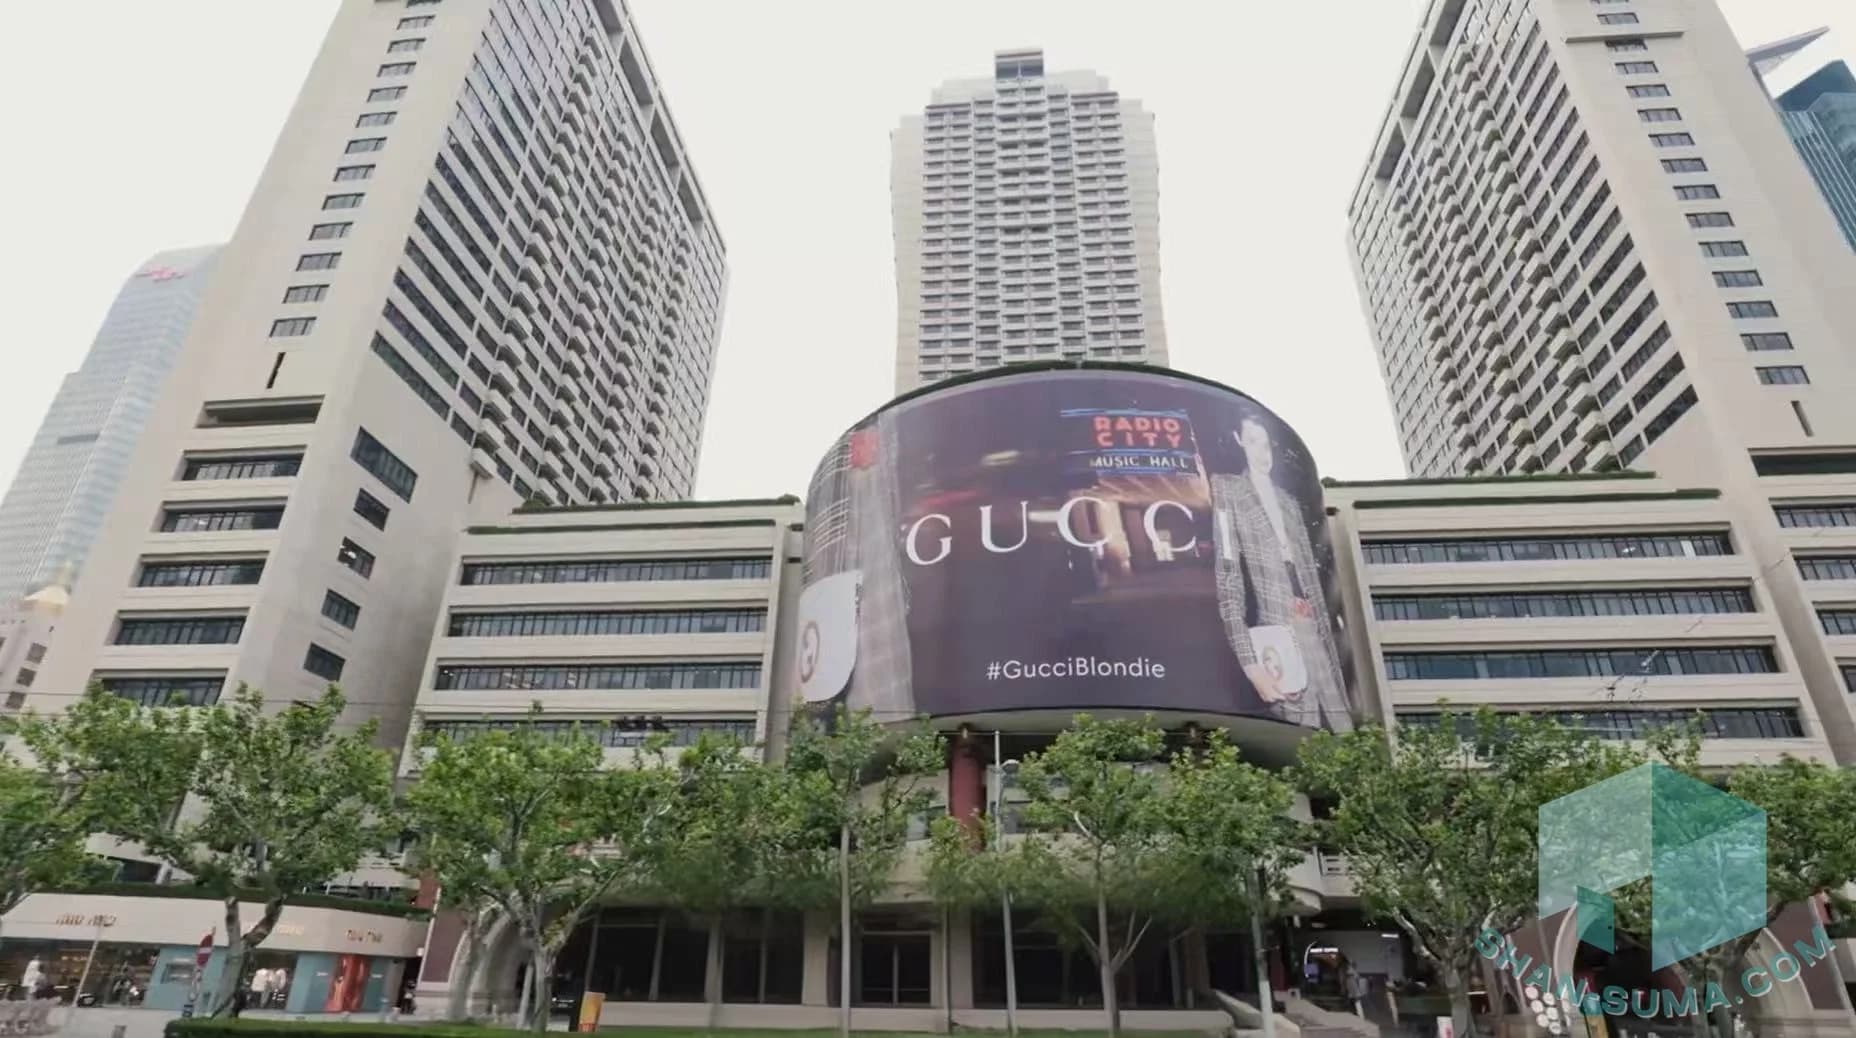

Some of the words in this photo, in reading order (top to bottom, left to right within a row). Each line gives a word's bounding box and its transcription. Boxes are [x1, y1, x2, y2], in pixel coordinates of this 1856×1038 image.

[1093, 416, 1181, 432] RADIO
[1096, 431, 1182, 448] CITY
[1089, 455, 1140, 468] MUSIC
[1149, 455, 1188, 469] HALL
[905, 496, 1233, 566] GUCCI
[986, 656, 1167, 681] #GucciBlondie
